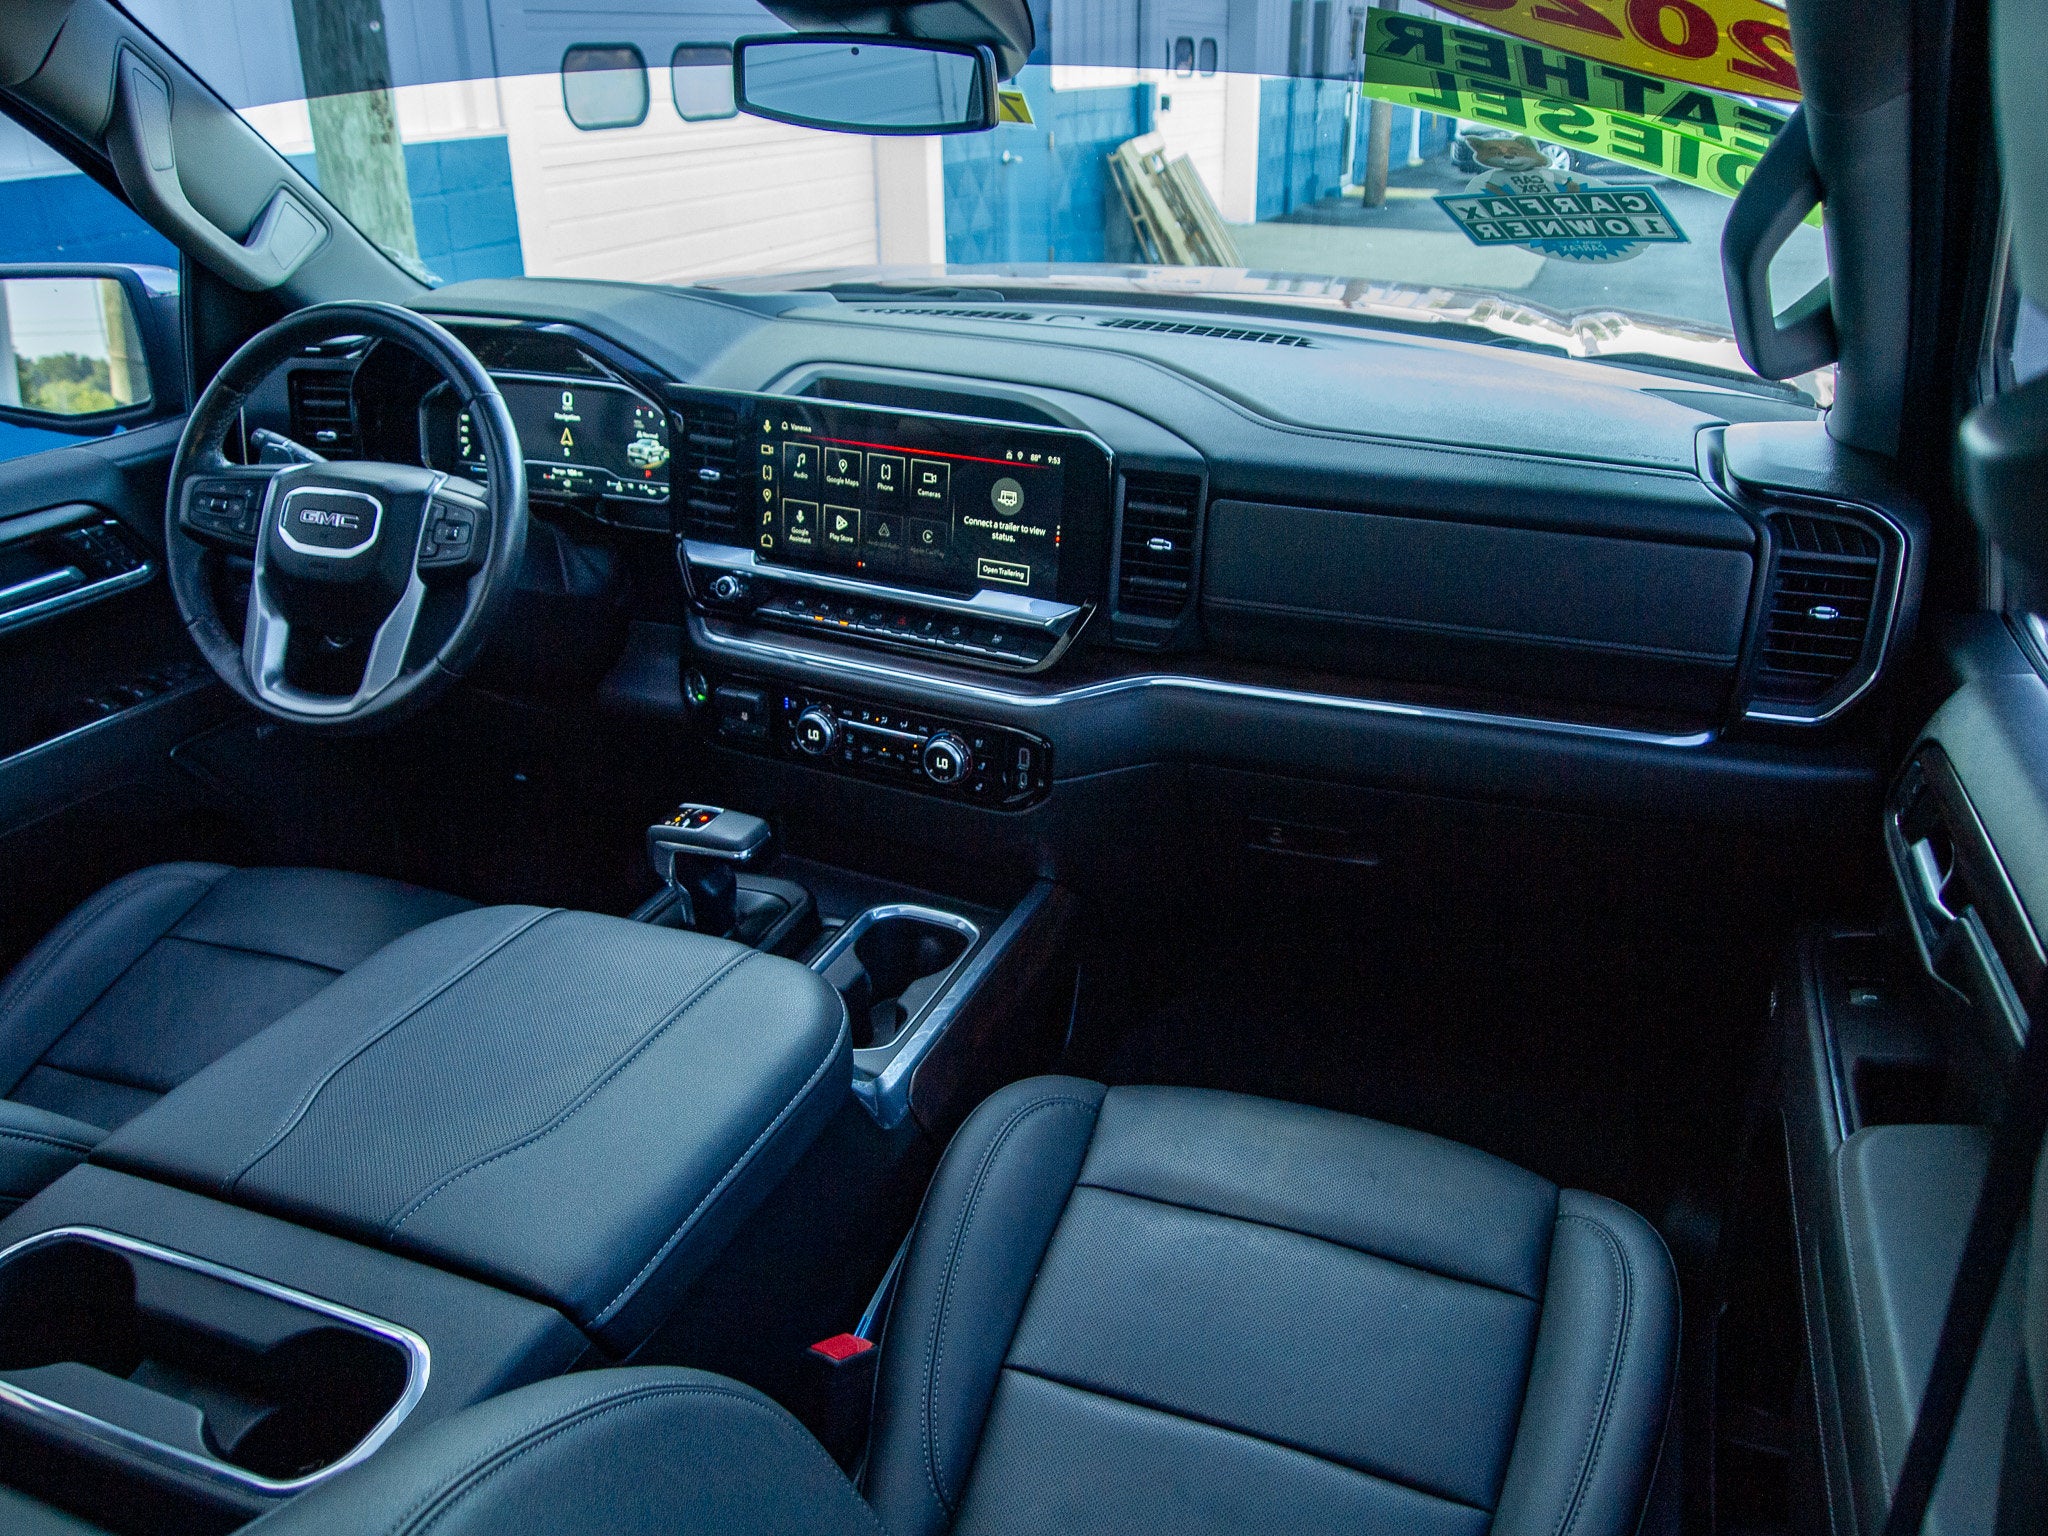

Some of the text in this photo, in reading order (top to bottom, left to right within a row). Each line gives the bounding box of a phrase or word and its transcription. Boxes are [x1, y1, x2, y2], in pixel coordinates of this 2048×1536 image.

[790, 423, 812, 433] Vanessa
[793, 471, 808, 479] Audio
[826, 475, 859, 487] Google Maps
[877, 483, 894, 491] Phone
[917, 488, 941, 498] Cameras
[299, 509, 360, 529] GMC
[791, 526, 809, 536] Google
[963, 516, 993, 528] Connect
[999, 520, 1020, 532] trailer
[1021, 525, 1029, 533] to
[1029, 526, 1046, 536] view
[829, 533, 854, 543] Play Store
[991, 532, 1016, 543] status.
[982, 565, 1025, 579] Open Trailering
